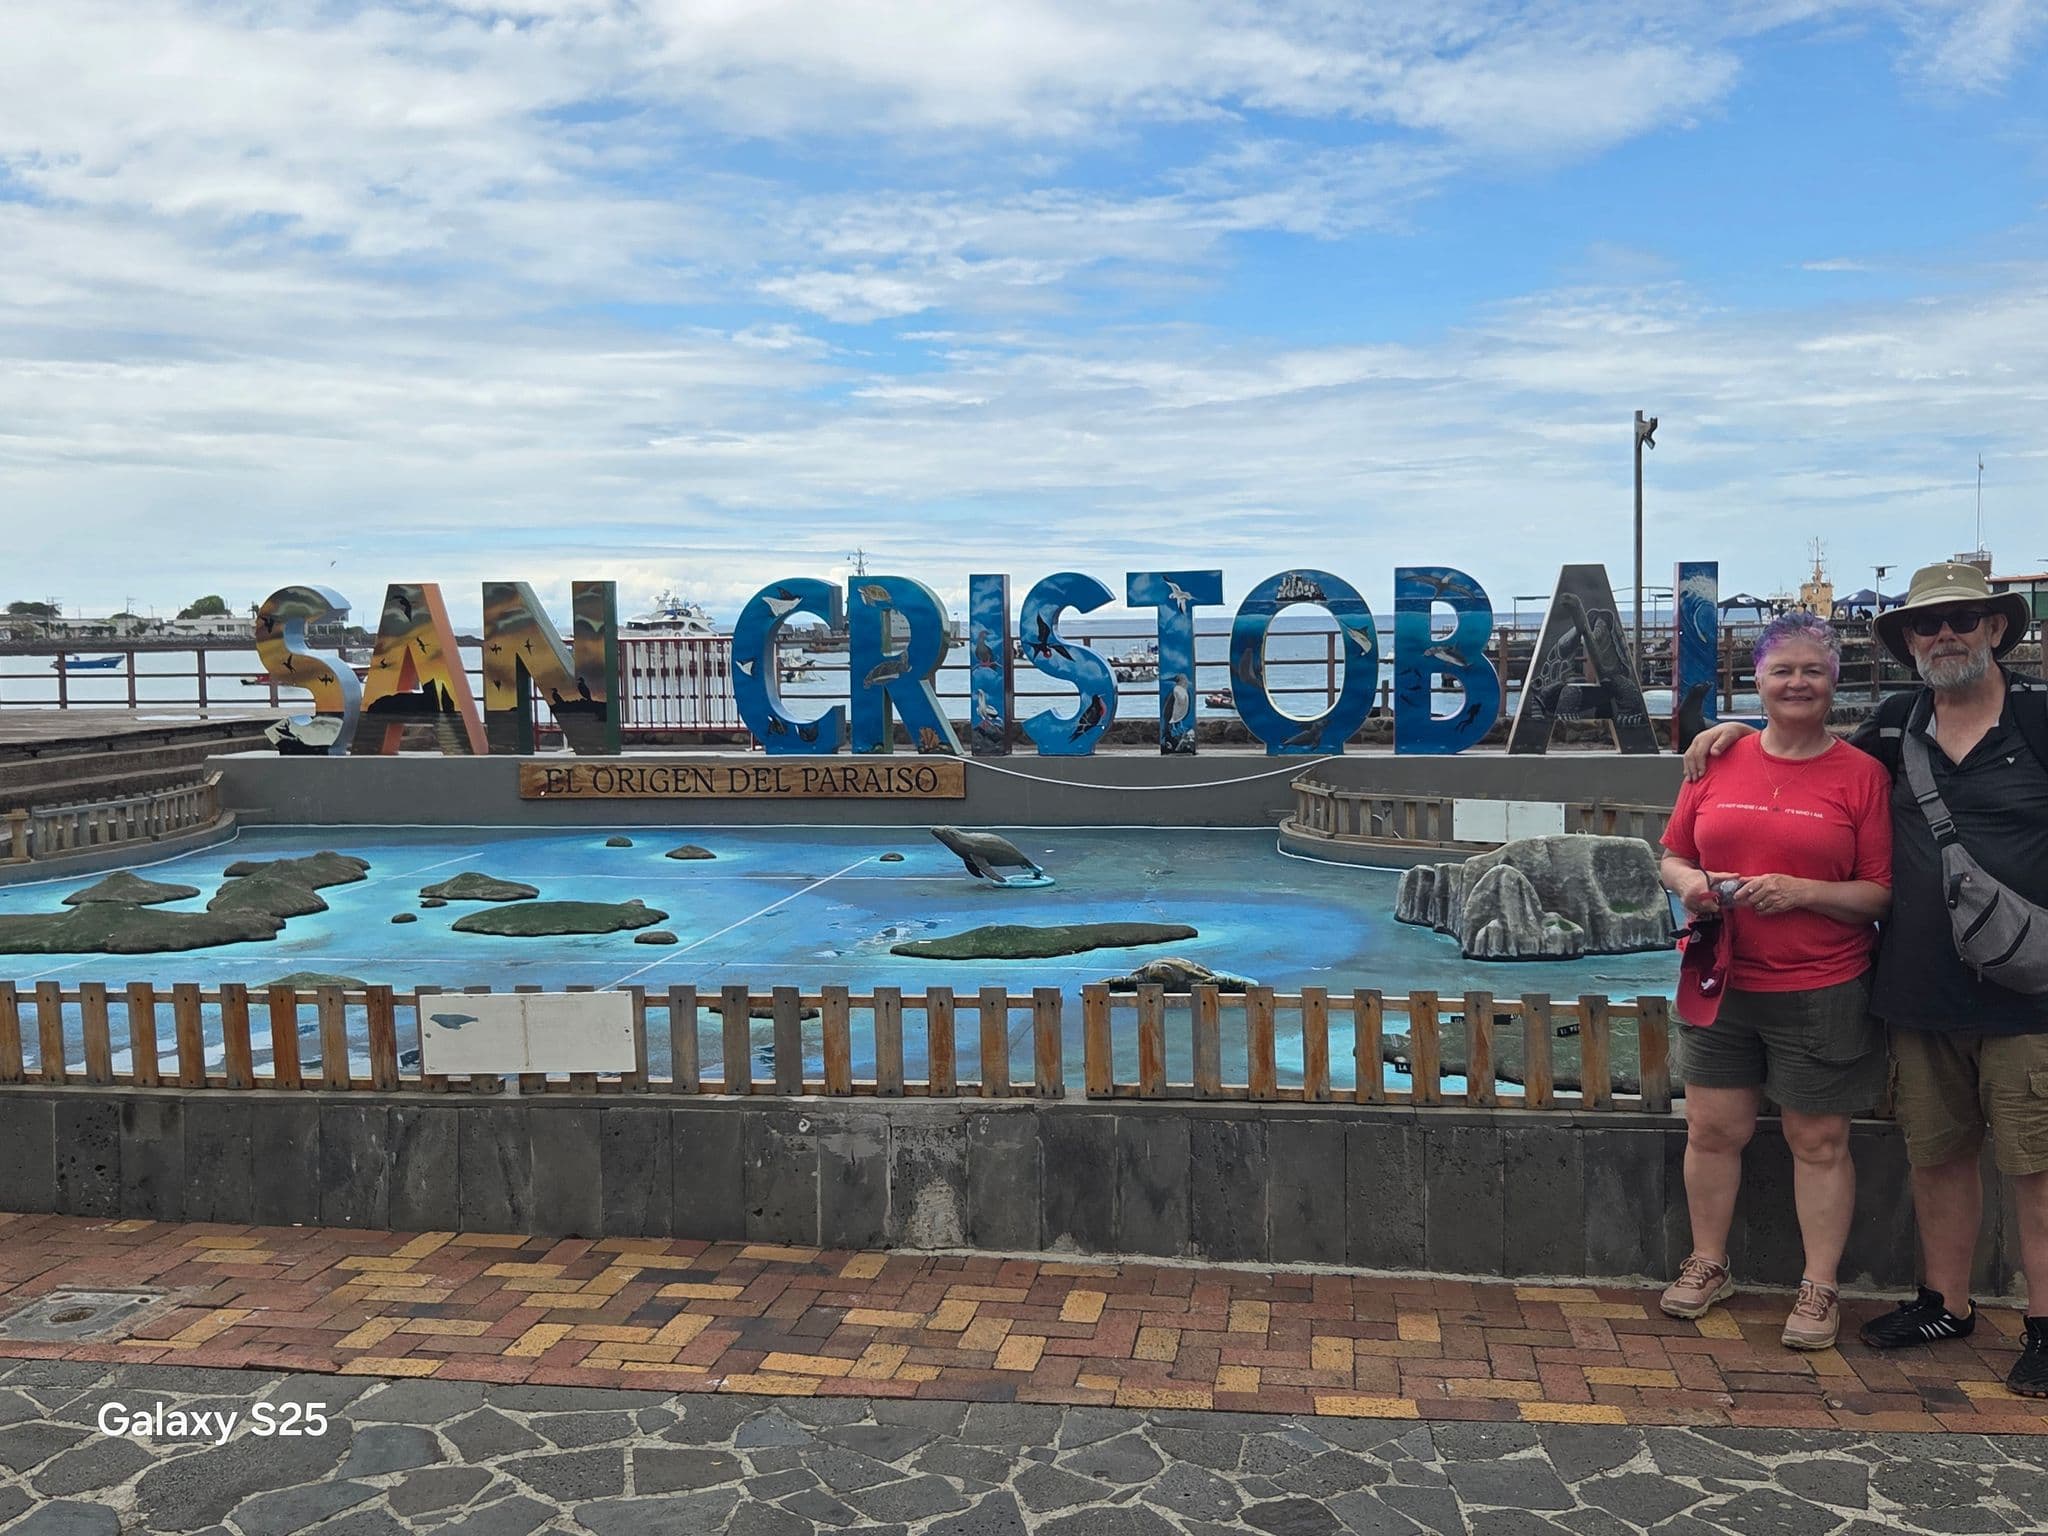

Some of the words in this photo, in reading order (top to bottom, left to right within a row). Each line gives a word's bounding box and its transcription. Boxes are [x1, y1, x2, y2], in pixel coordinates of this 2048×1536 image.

[255, 580, 621, 756] SAN
[733, 561, 1766, 757] CRISTOBAL
[546, 768, 582, 794] EL
[593, 766, 715, 794] ORIGEN
[727, 767, 791, 794] DEL
[803, 766, 939, 794] PARAISO
